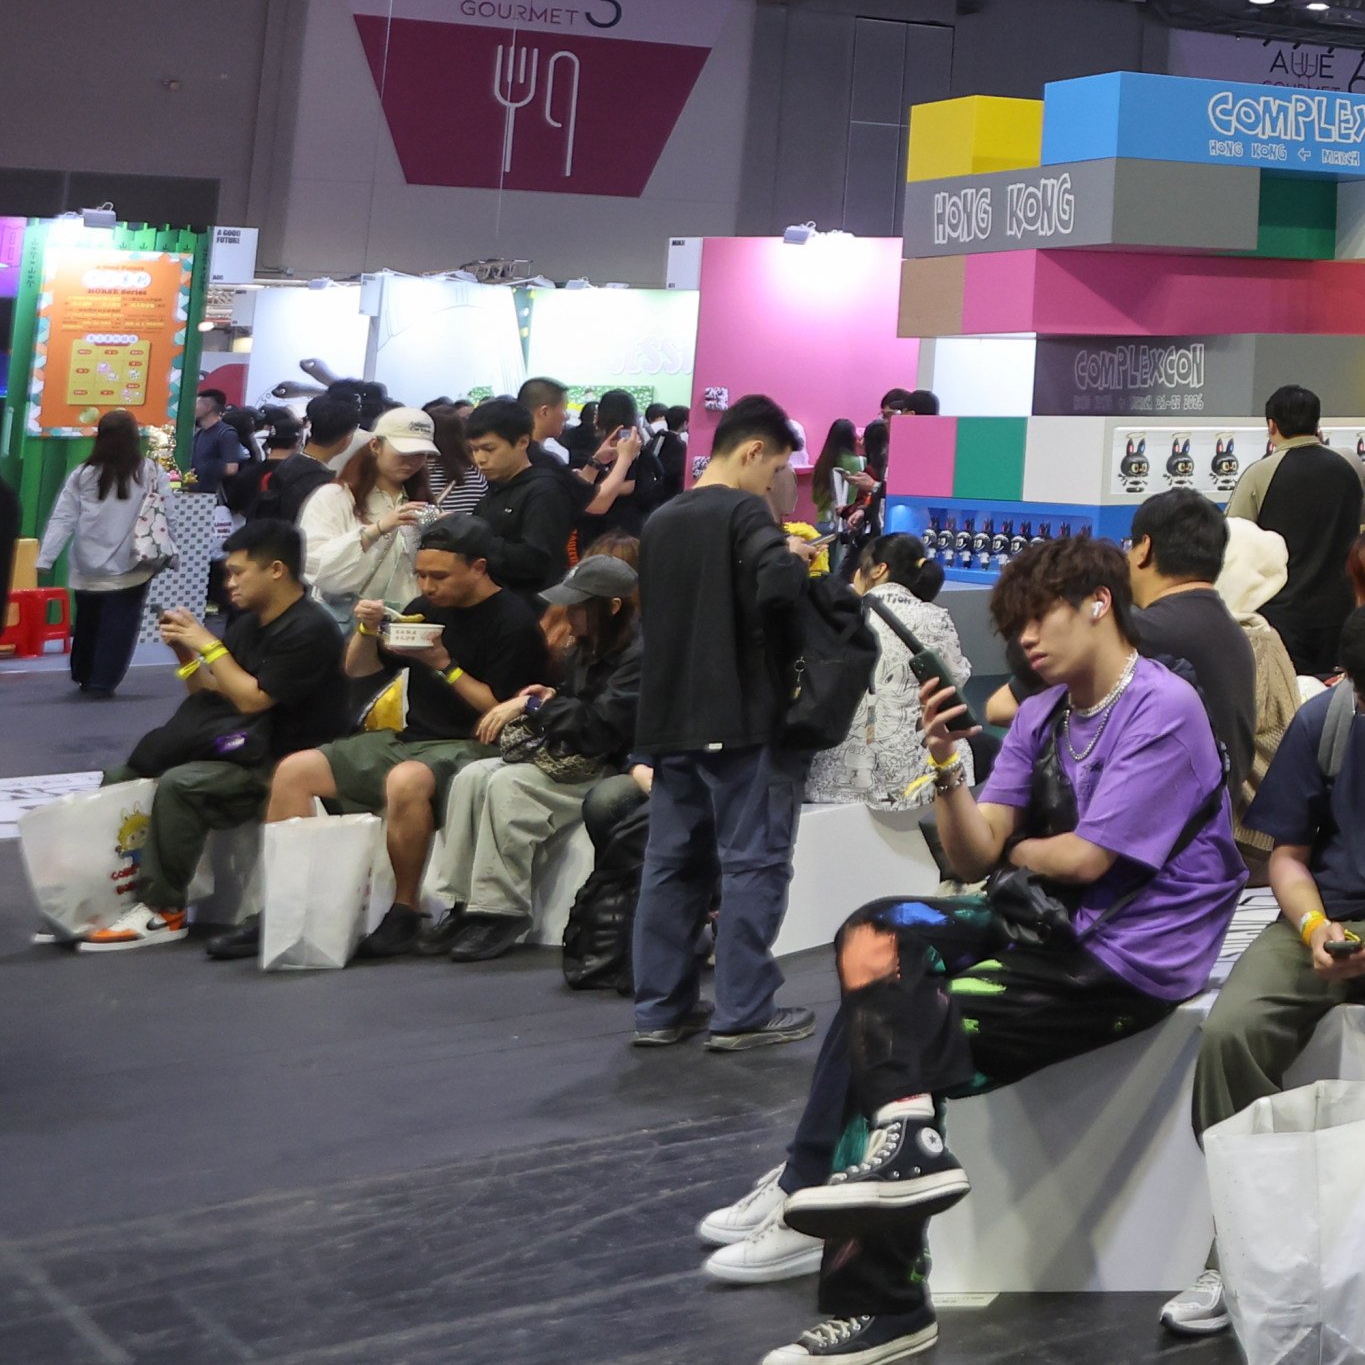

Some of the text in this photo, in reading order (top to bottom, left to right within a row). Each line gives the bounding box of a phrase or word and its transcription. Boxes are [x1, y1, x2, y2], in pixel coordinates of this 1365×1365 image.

[460, 0, 579, 25] GOURMET
[1209, 140, 1243, 157] HONG
[1251, 143, 1287, 161] KONG
[1322, 148, 1360, 167] MARCH
[935, 173, 1075, 244] HONG KONG
[1074, 343, 1205, 390] COMPLEXCON
